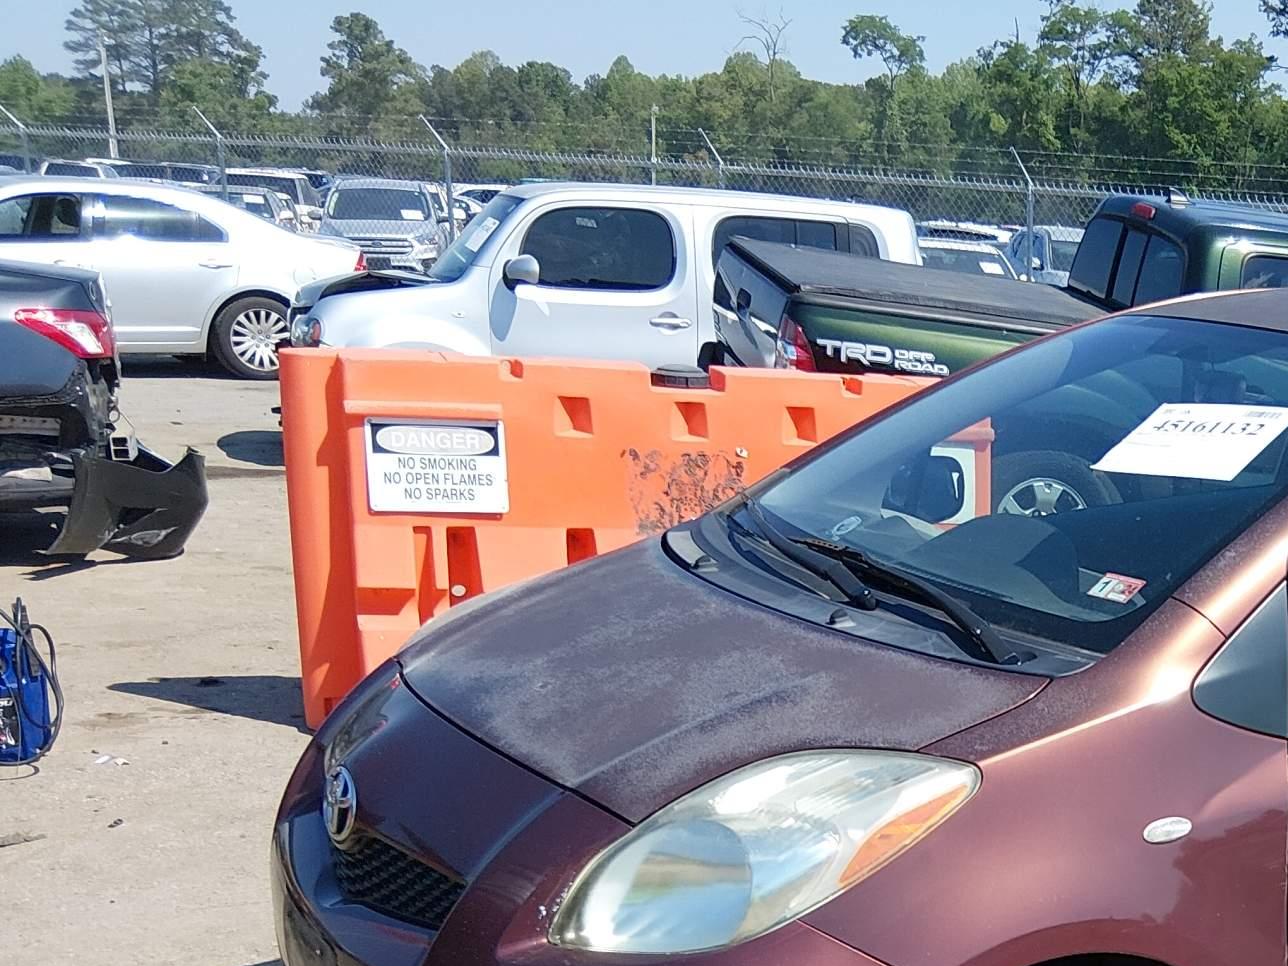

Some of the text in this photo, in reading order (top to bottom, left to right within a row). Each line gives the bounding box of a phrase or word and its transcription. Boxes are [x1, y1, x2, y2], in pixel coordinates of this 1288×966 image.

[816, 338, 936, 367] TRD OFF
[894, 360, 950, 376] ROAD
[1153, 419, 1266, 436] 45161132
[391, 431, 480, 449] DANGER
[398, 457, 477, 471] NO SMOKING
[384, 472, 494, 487] NO OPEN FLAMES
[404, 488, 476, 501] NO SPARKS
